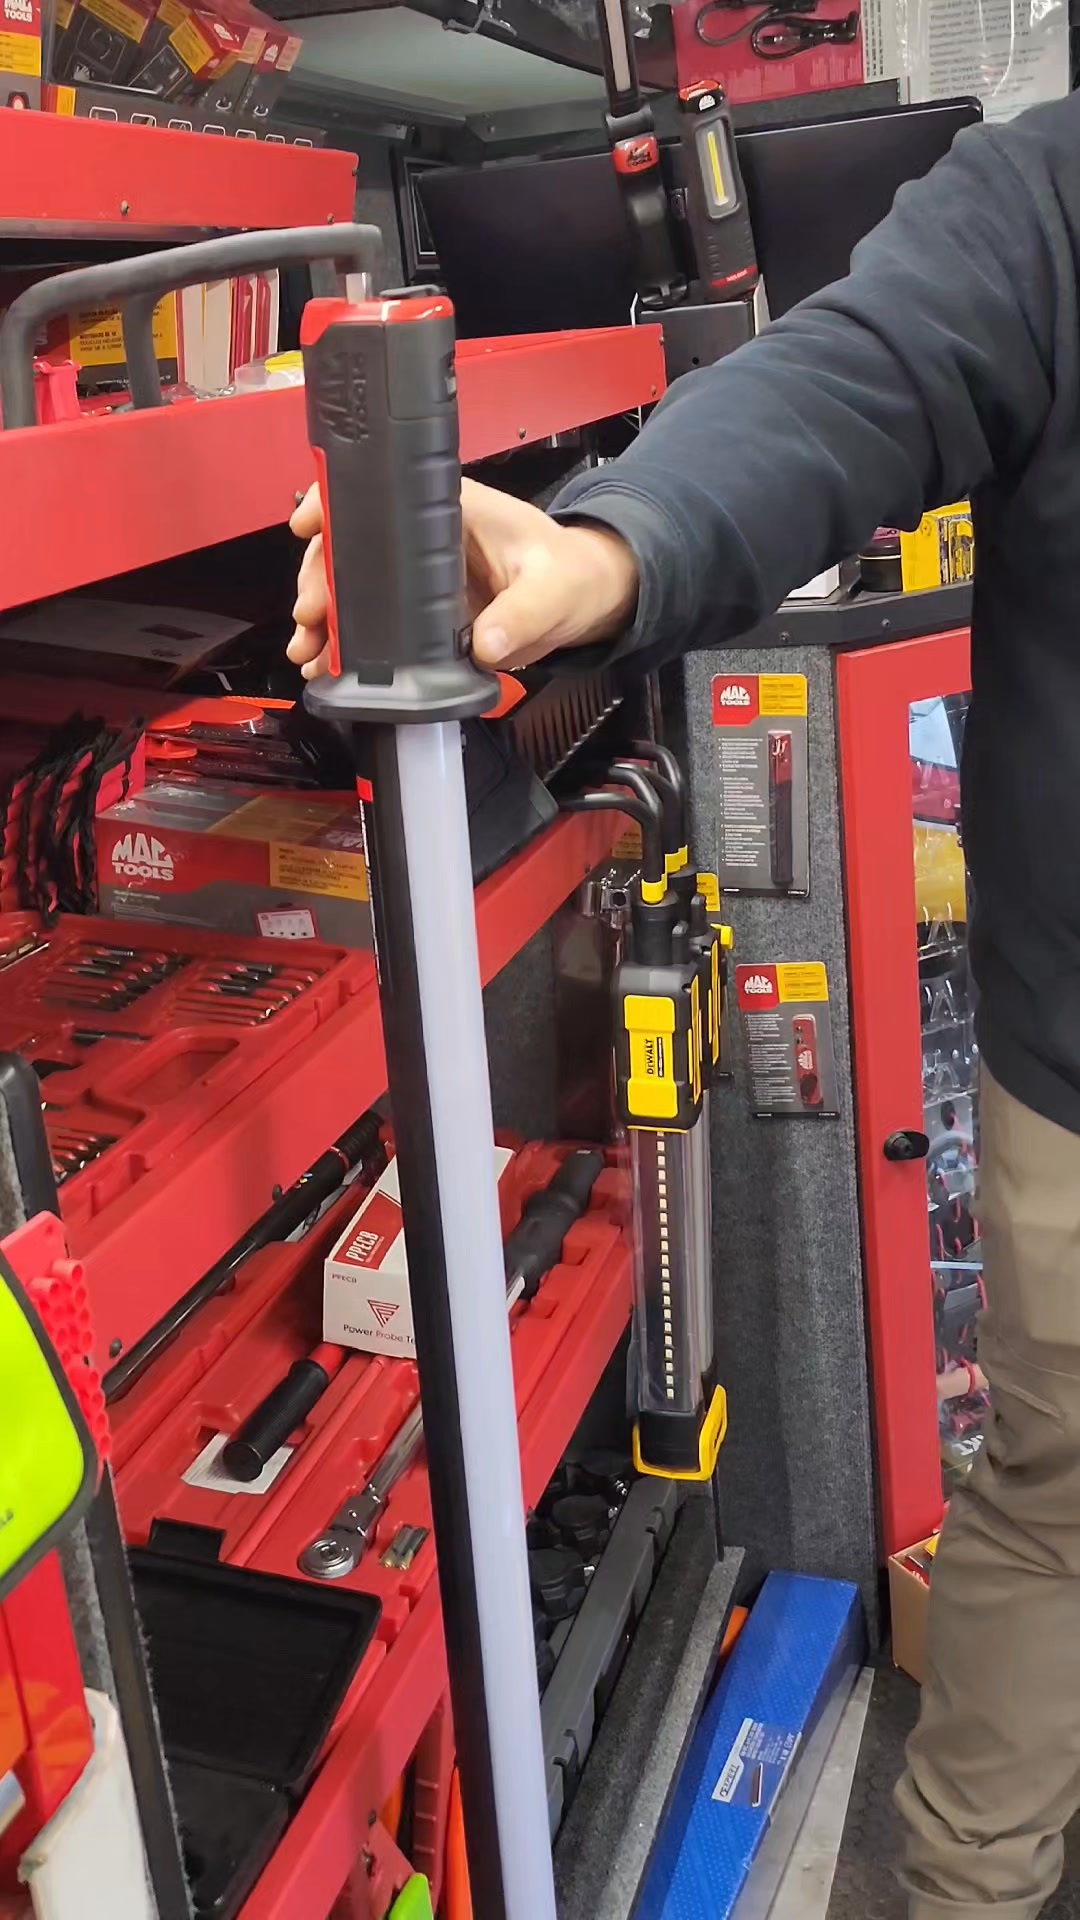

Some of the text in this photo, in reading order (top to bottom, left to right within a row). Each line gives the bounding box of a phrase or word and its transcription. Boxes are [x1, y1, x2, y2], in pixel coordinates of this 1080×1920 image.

[5, 9, 32, 22] TOOLS
[720, 685, 750, 701] MAC
[111, 833, 174, 869] MAC
[112, 862, 175, 881] TOOLS
[744, 975, 772, 990] MAC
[645, 1039, 655, 1075] DEWALT
[345, 1230, 379, 1262] PPECB
[331, 1273, 357, 1284] PPECB
[343, 1324, 373, 1337] Power
[375, 1330, 404, 1343] Probe
